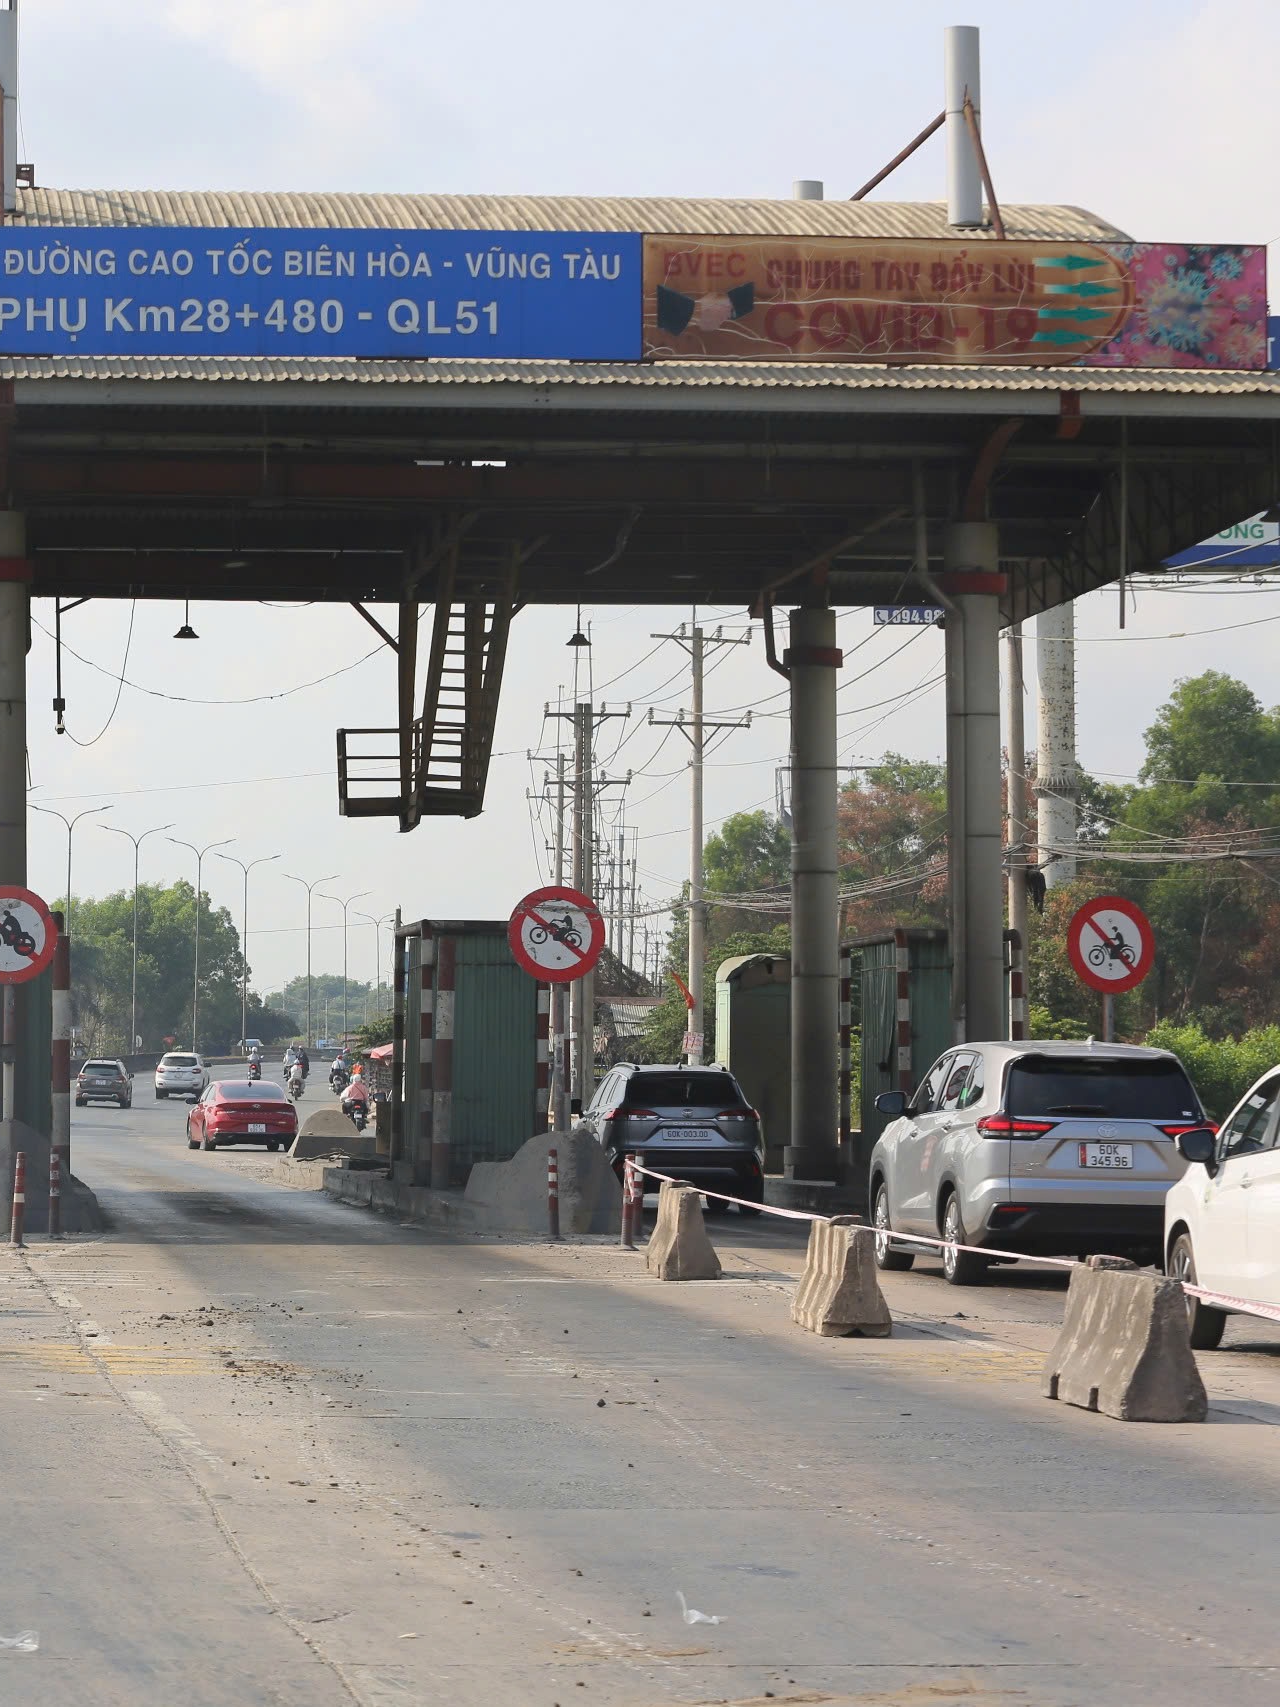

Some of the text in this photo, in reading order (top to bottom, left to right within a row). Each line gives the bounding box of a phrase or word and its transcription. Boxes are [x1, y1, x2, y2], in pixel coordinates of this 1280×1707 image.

[4, 240, 116, 276] ĐƯỜNG
[128, 248, 194, 276] CAO
[206, 238, 273, 276] TỐC
[284, 244, 356, 277] BIÊN
[367, 244, 433, 278] HÒA
[465, 246, 551, 279] VŨNG
[563, 247, 621, 280] TÀU
[663, 252, 745, 278] BVEC
[767, 259, 860, 291] CHUNG
[871, 260, 920, 291] TAY
[105, 298, 345, 334] Km28+480
[387, 298, 498, 335] QL51
[764, 302, 1039, 353] COVID-19
[1091, 1155, 1128, 1167] 345.96
[1099, 1144, 1119, 1155] 60K
